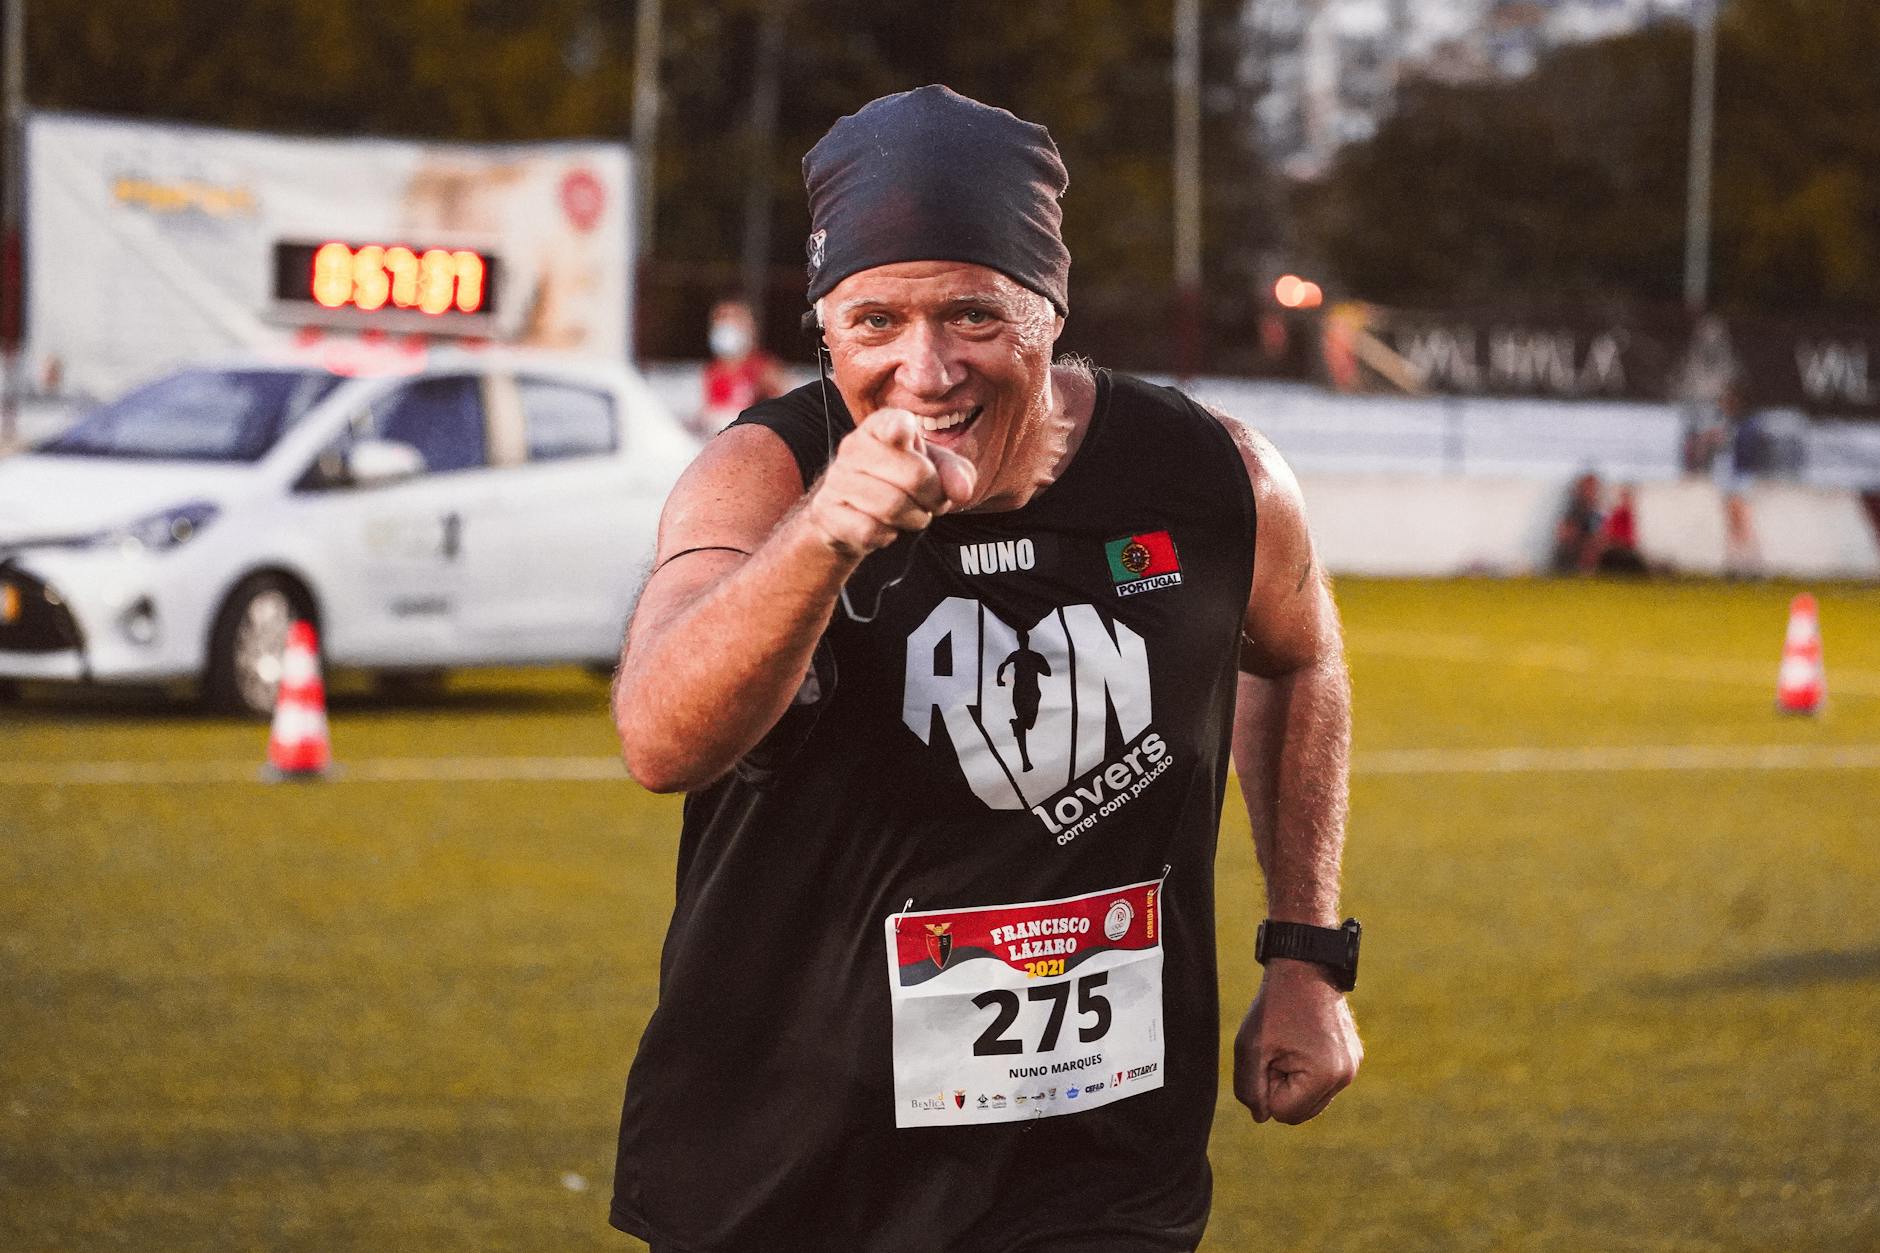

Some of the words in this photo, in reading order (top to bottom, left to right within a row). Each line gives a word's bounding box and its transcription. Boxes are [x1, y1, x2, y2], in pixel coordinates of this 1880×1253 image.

[960, 538, 1036, 576] NUNO
[1118, 574, 1181, 596] PORTUGAL
[902, 596, 1153, 810] RUN
[1032, 732, 1167, 835] lovers
[1056, 814, 1098, 846] correr
[1099, 791, 1131, 818] com
[1130, 755, 1174, 800] paixão
[990, 917, 1090, 945] FRANCISCO
[1146, 907, 1154, 939] CORRIDA
[1008, 937, 1077, 961] LÁZARO
[1024, 959, 1065, 980] 2021
[971, 971, 1112, 1057] 275
[1009, 1065, 1048, 1079] NUNO
[1051, 1053, 1102, 1076] MARQUES
